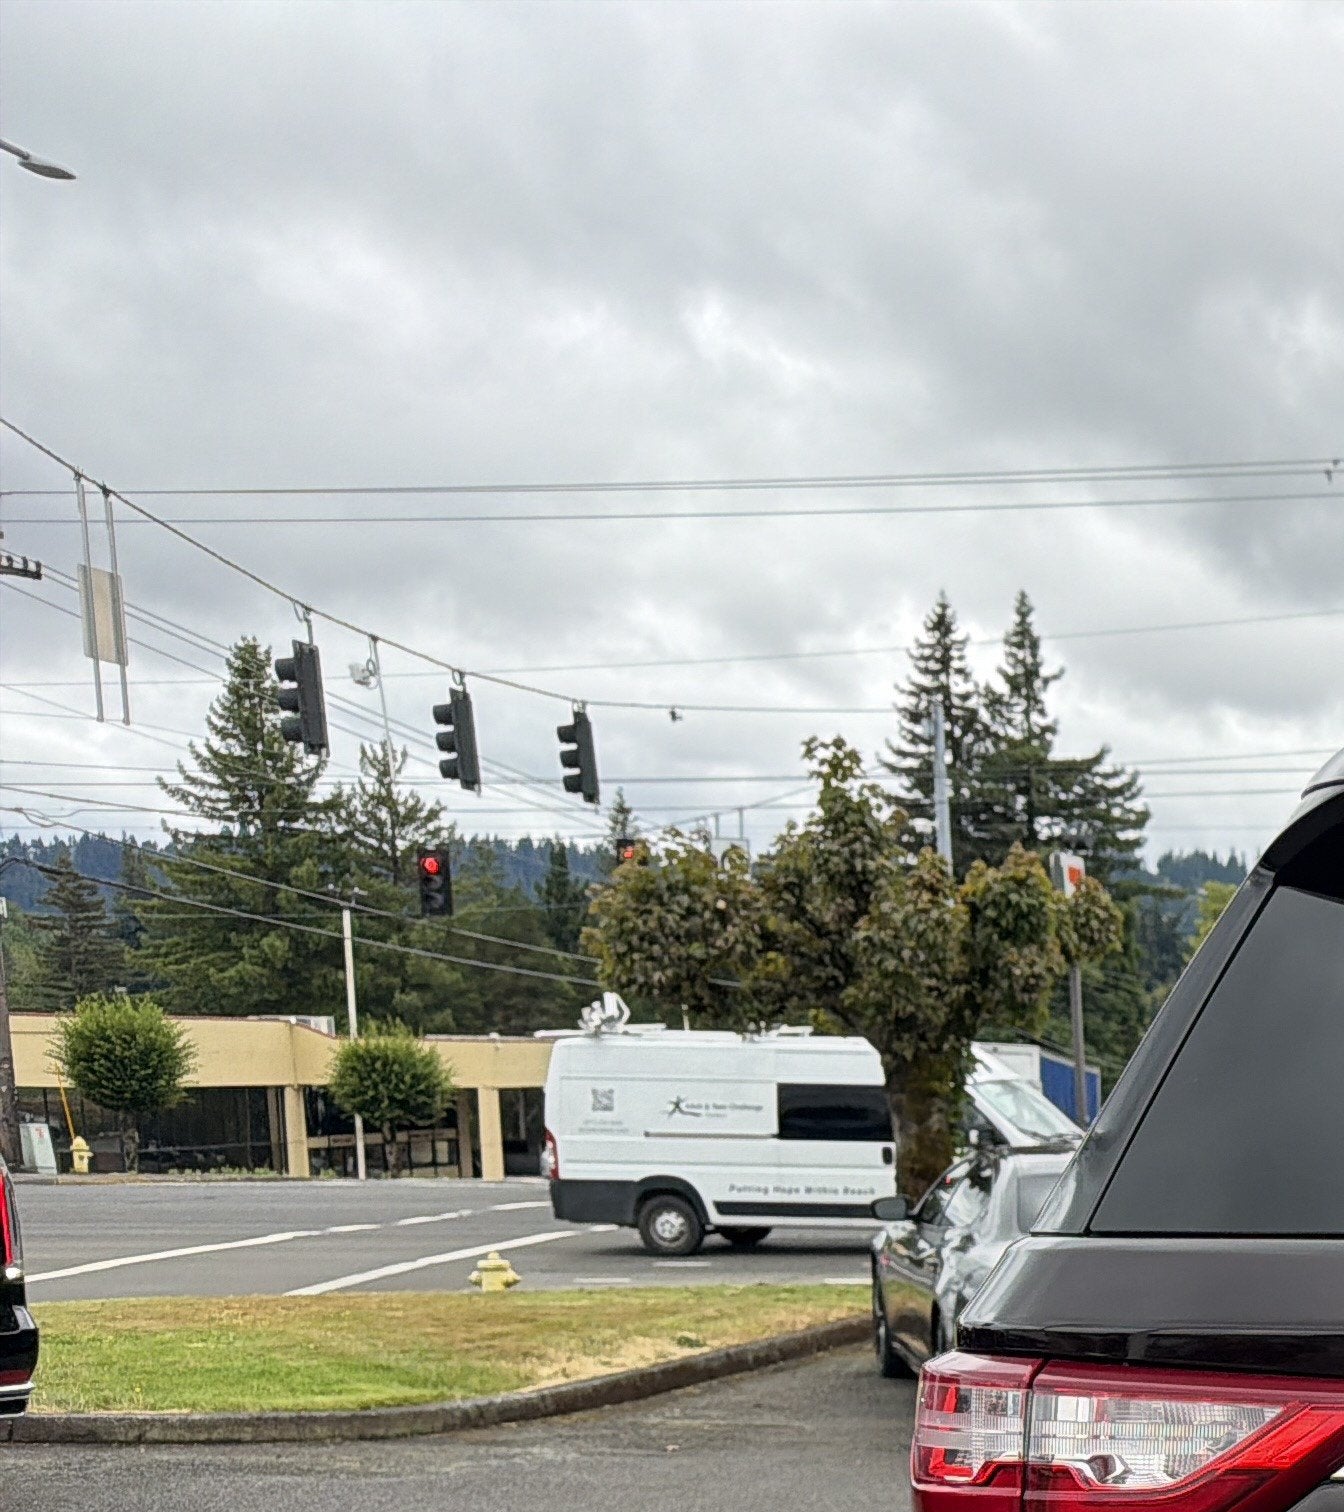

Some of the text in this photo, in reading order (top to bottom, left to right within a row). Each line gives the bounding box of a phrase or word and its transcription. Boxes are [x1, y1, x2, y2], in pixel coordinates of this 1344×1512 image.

[728, 1183, 876, 1196] Putting Hope Within Reach
